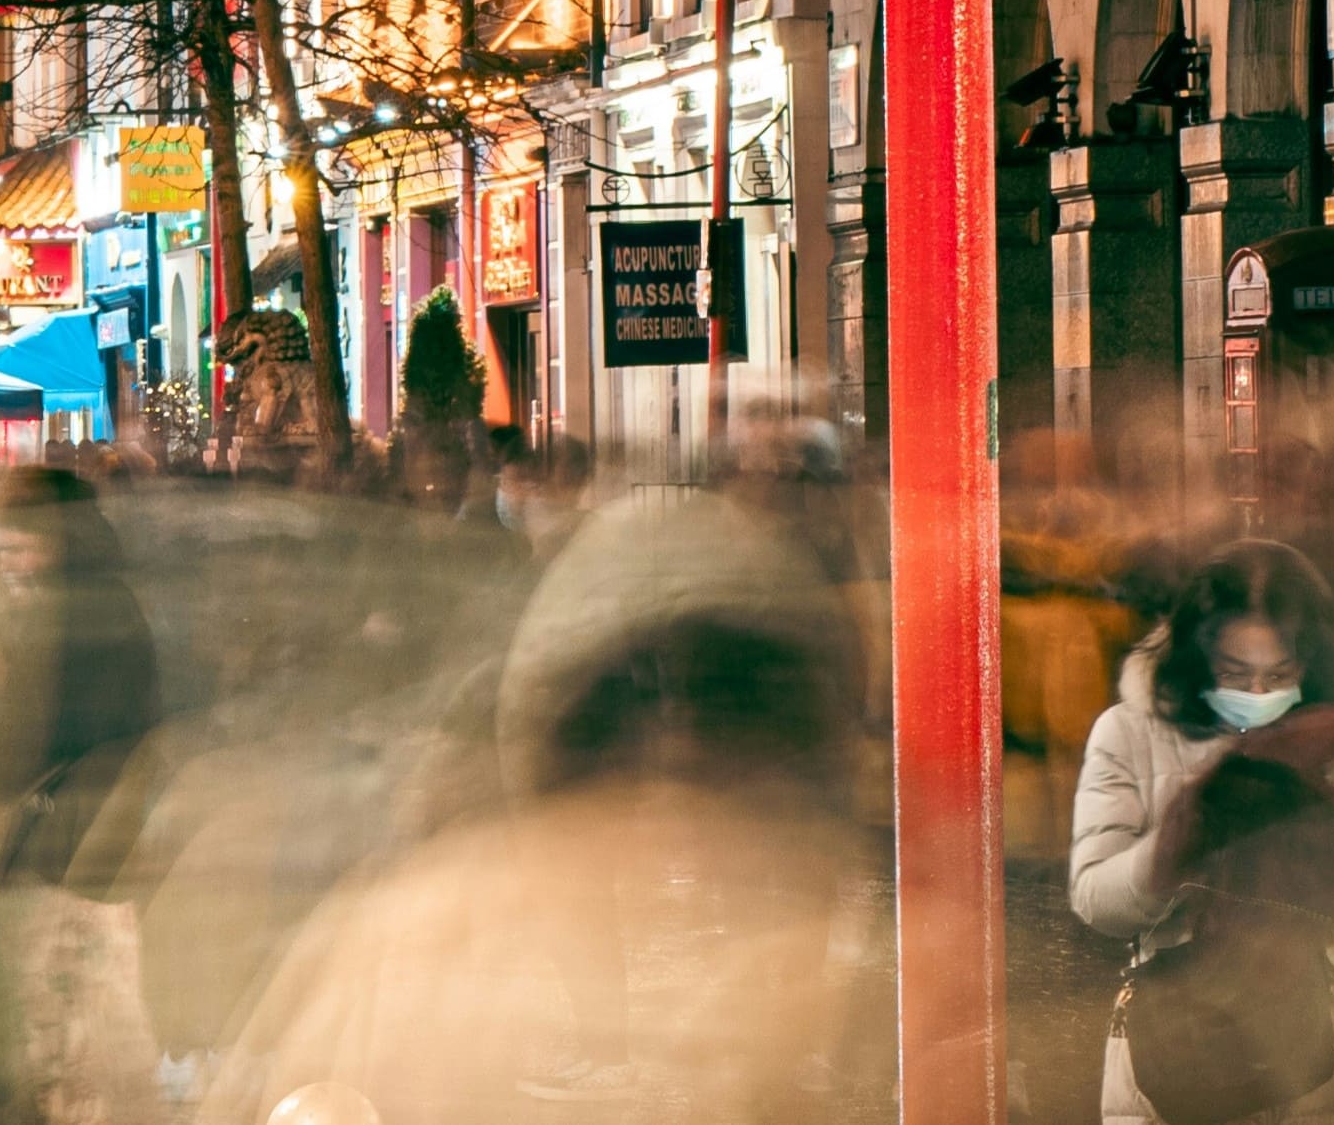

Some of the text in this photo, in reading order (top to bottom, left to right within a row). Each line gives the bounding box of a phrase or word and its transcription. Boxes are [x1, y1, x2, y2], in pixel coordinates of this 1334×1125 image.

[614, 245, 701, 273] ACUPUNCTUR
[615, 282, 697, 308] MASSAG
[617, 317, 660, 341] CHINESE
